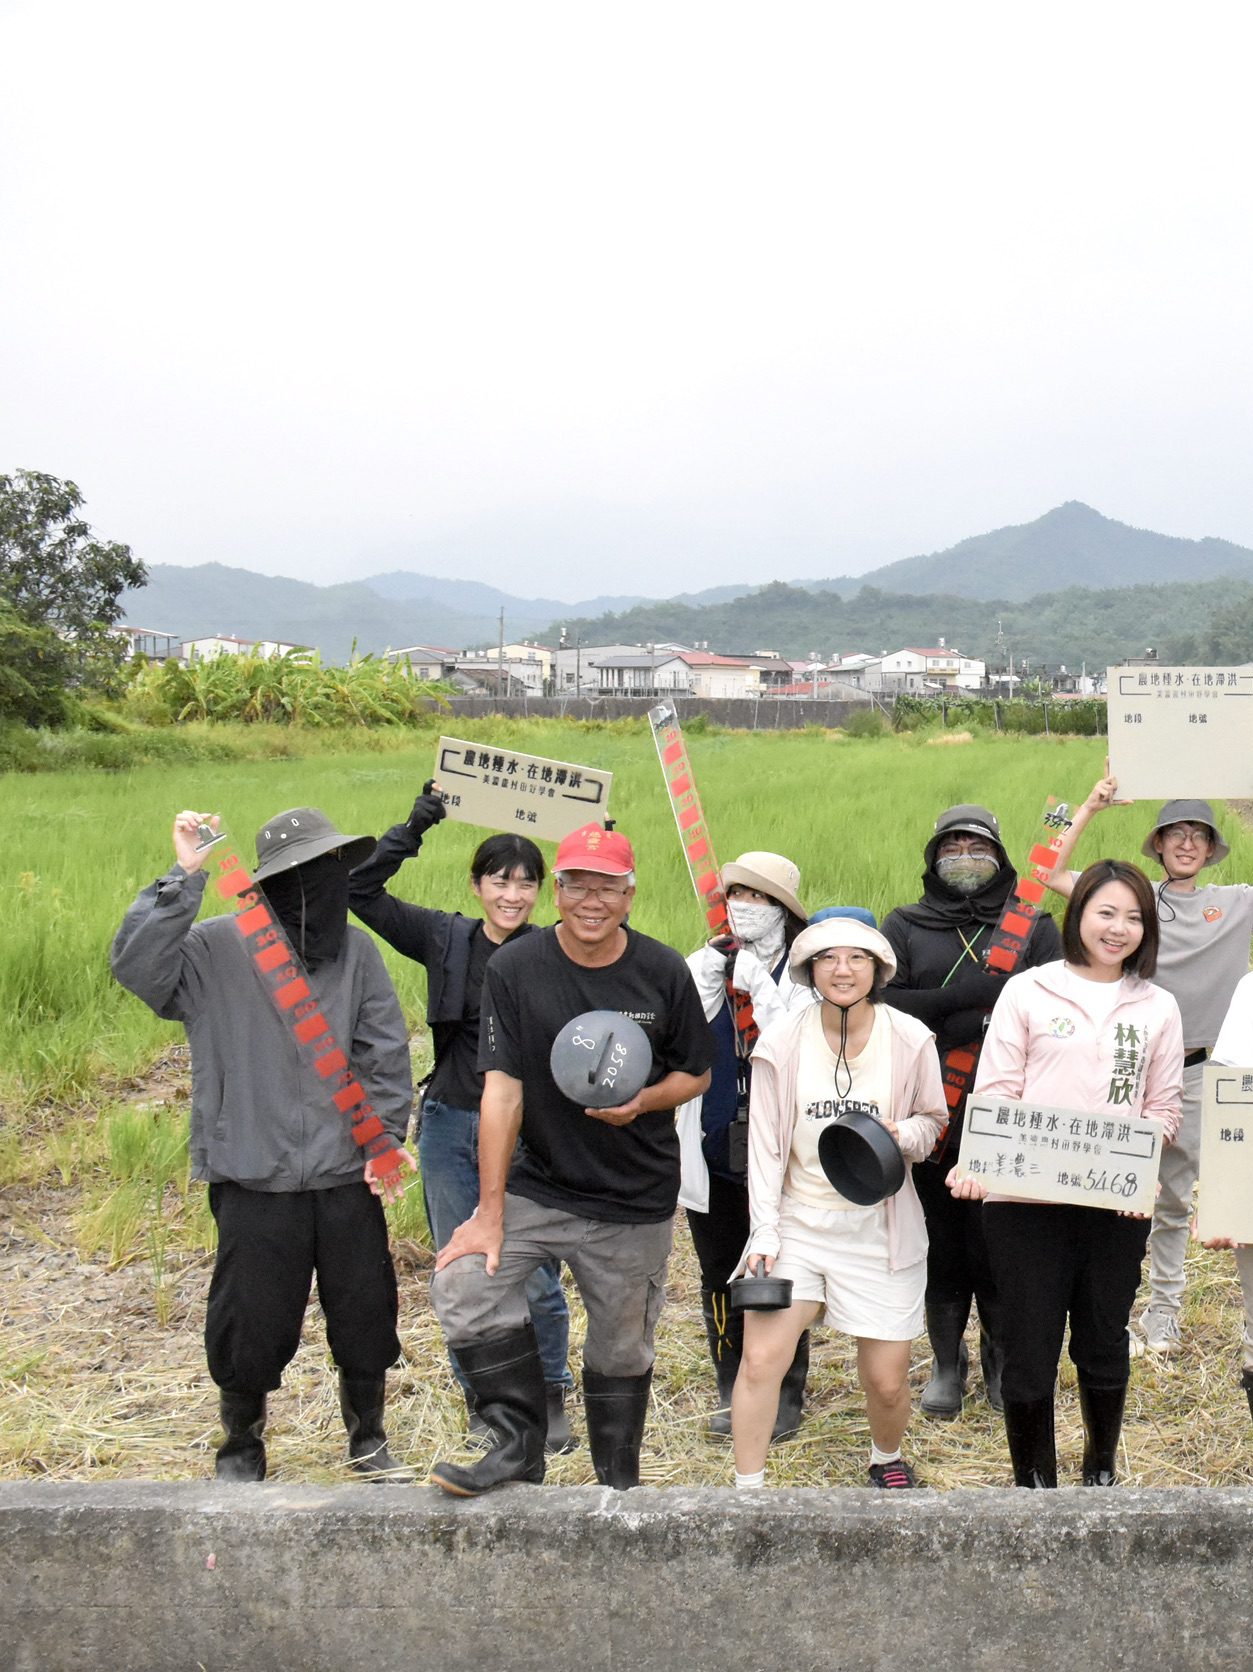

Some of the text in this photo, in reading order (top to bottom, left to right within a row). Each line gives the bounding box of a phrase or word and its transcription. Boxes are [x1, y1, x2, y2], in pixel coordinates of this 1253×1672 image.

[219, 854, 239, 872] 10
[1031, 868, 1050, 882] 20
[1016, 903, 1036, 917] 30
[602, 1043, 627, 1089] 2058
[1107, 1023, 1140, 1106] 林慧欣
